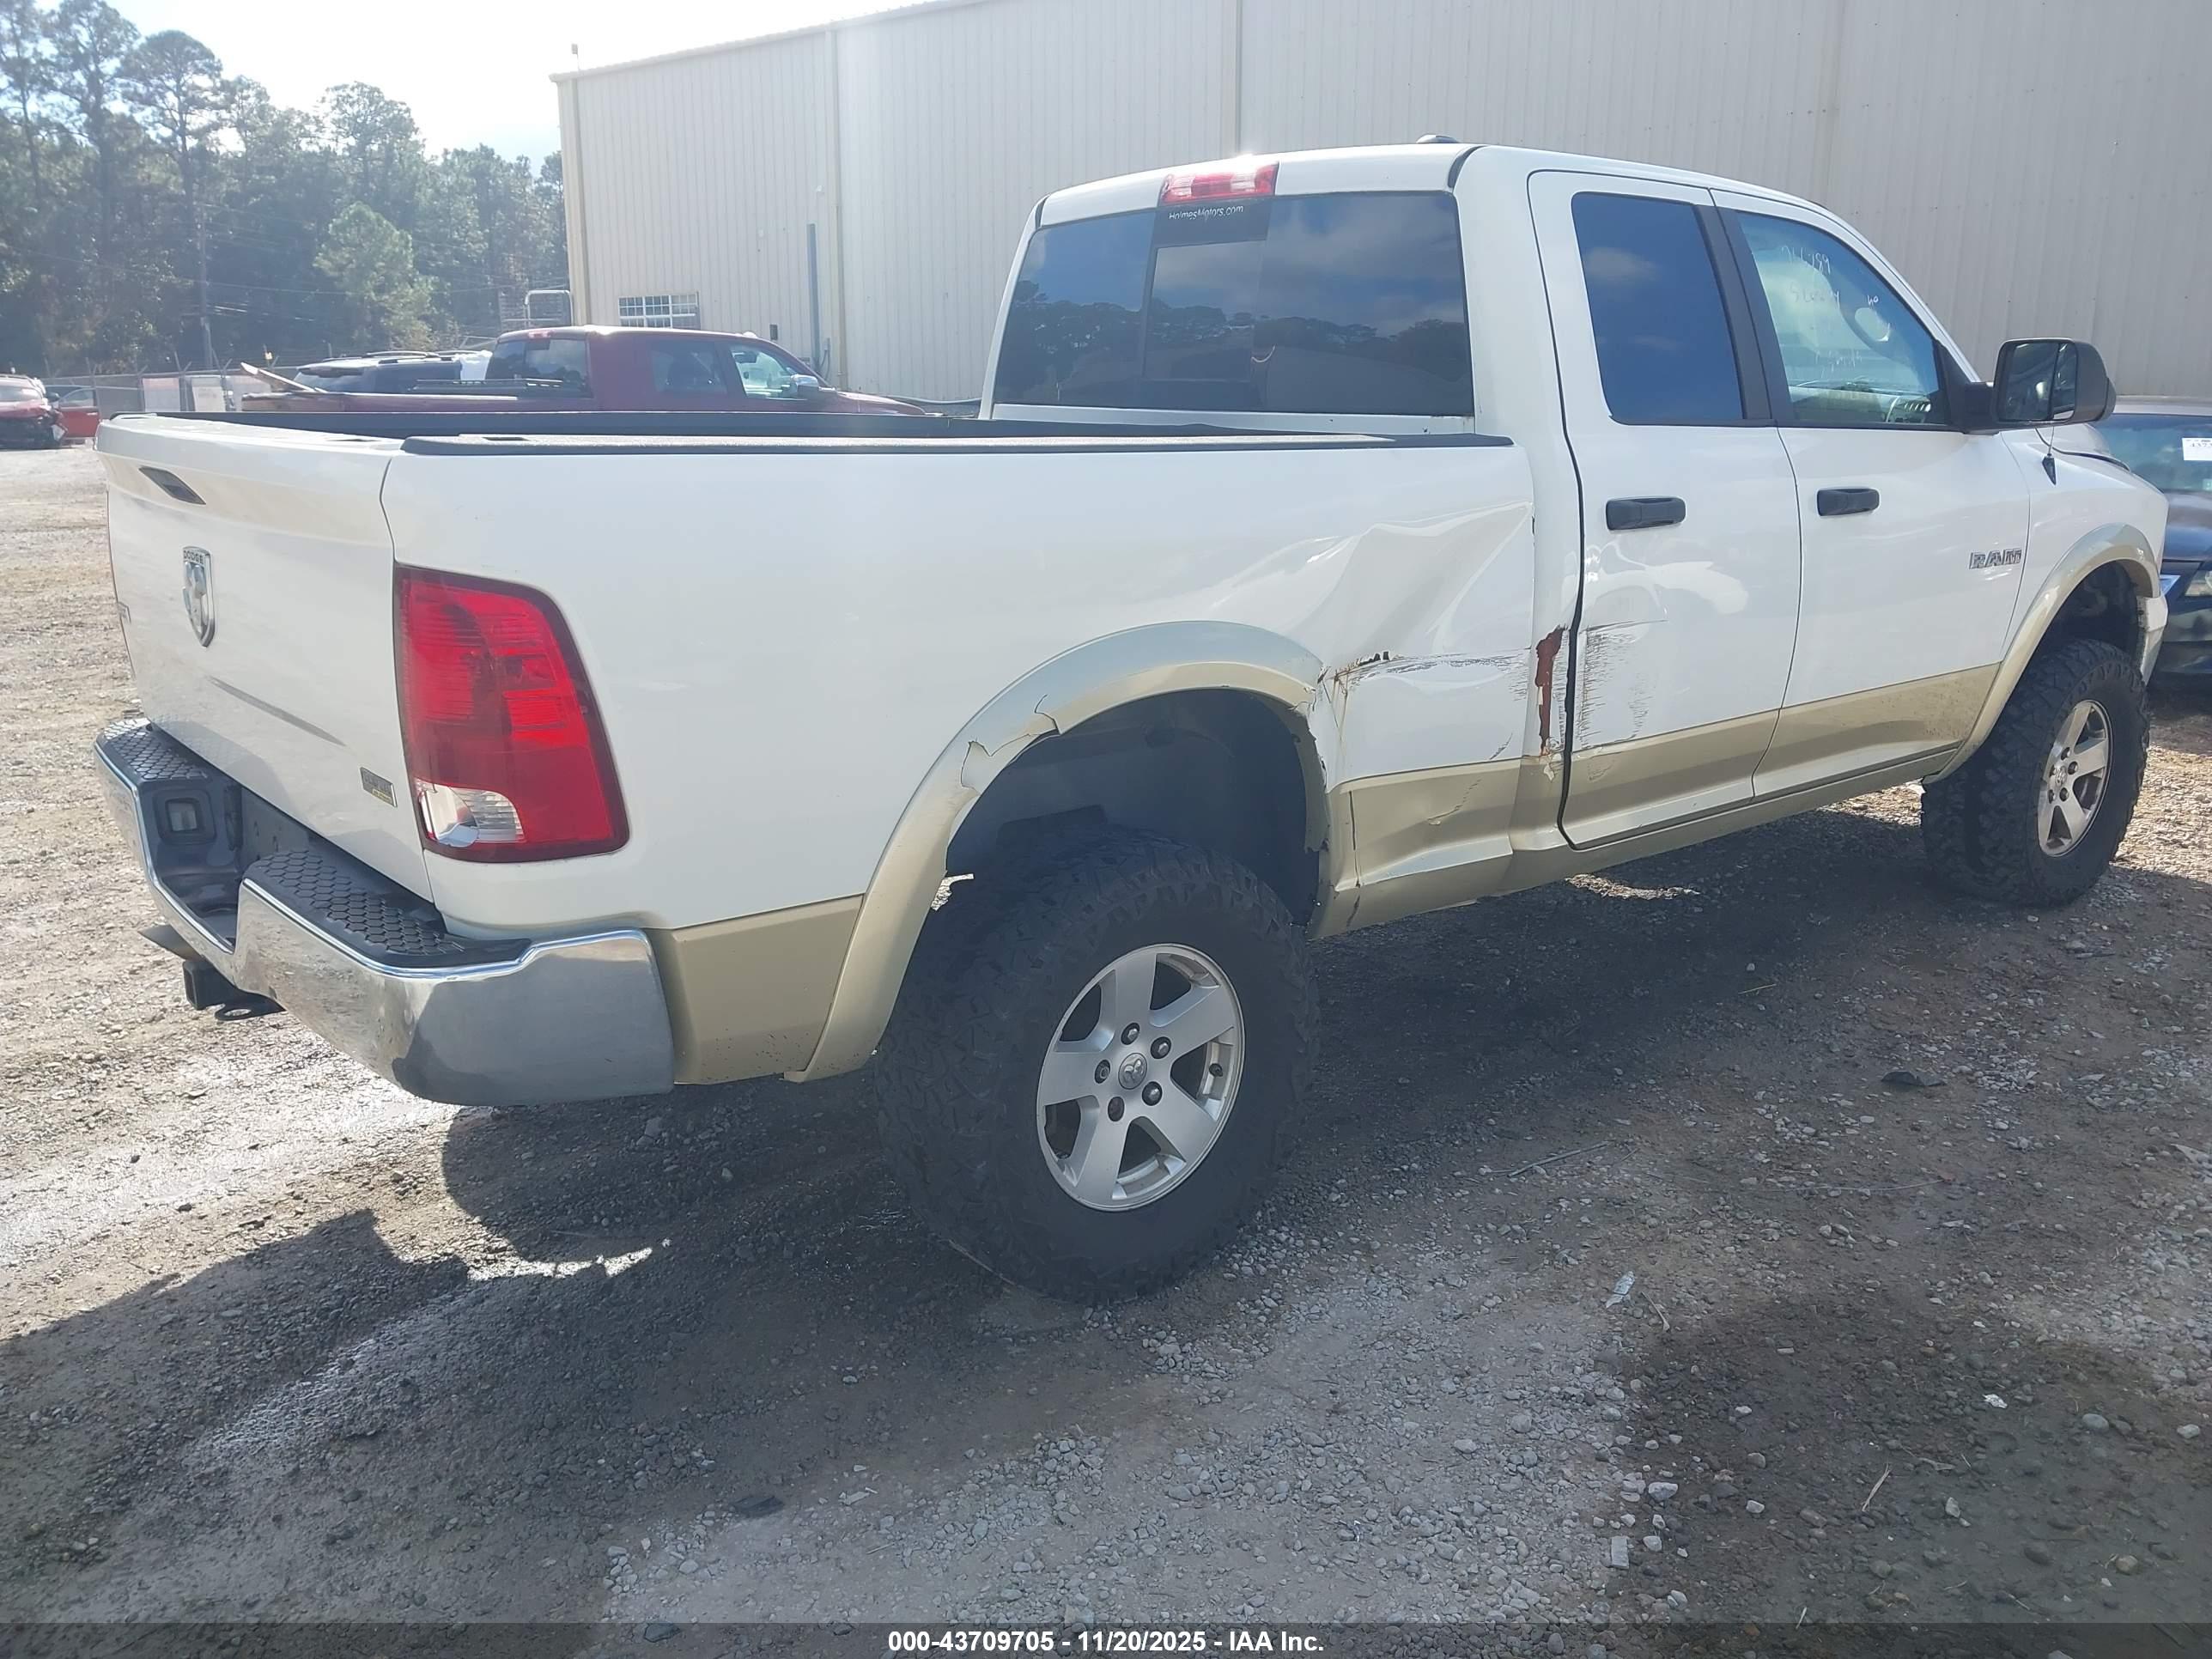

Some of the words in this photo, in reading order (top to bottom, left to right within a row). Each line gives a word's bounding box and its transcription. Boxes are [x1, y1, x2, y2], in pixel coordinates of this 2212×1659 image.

[1169, 205, 1243, 220] HolmesMotors.com
[183, 550, 204, 564] DODGE
[1969, 549, 2021, 569] RAM
